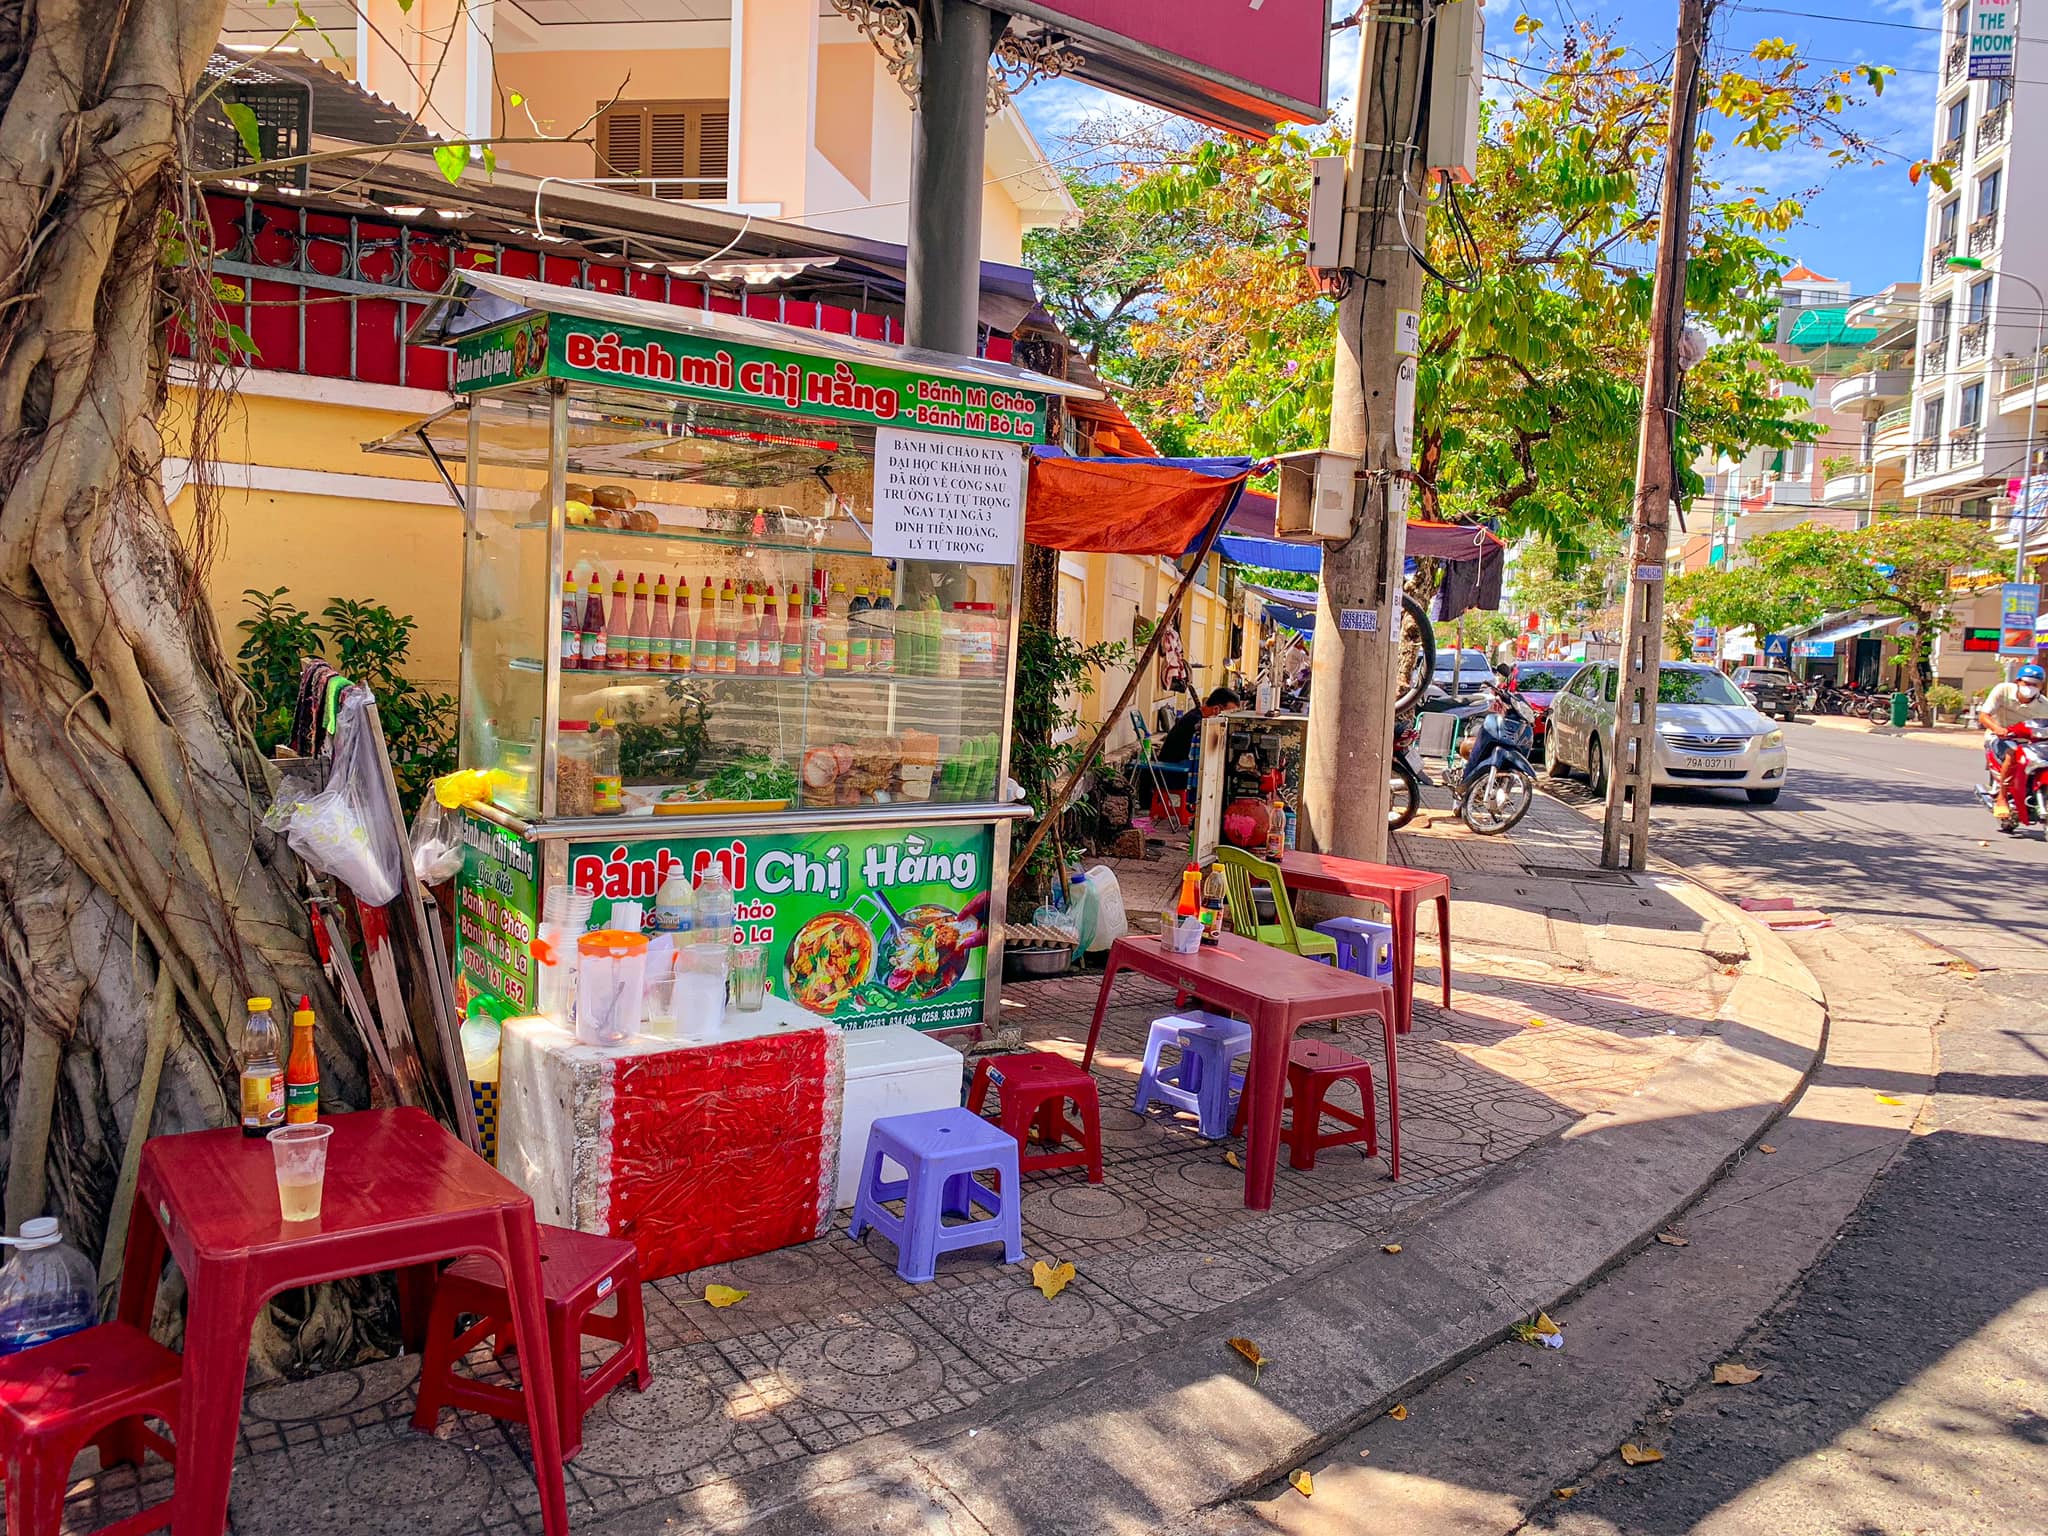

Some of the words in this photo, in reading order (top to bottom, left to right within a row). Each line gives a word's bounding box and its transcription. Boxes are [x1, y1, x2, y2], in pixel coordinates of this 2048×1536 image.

[1979, 12, 2006, 30] THE
[1972, 34, 2012, 52] MOON
[566, 332, 676, 382] Bánh
[680, 350, 734, 390] mì
[739, 361, 802, 408] Chị
[807, 361, 899, 419] Hằng
[917, 380, 962, 404] Bánh
[966, 384, 987, 408] Mì
[991, 391, 1036, 413] Chảo
[917, 404, 962, 427] Bánh
[965, 409, 986, 431] Mì
[989, 412, 1011, 434] Bò
[1014, 418, 1034, 437] La
[982, 448, 1004, 461] KTX
[889, 456, 910, 470] ĐẠI
[913, 459, 938, 474] HỌC
[985, 482, 1006, 493] SAU
[972, 496, 1011, 509] TRỌNG
[903, 505, 936, 519] NGAY
[938, 509, 957, 521] TẠI
[986, 511, 992, 522] 3
[946, 541, 984, 554] TRỌNG
[862, 833, 978, 889] Hằng
[462, 885, 484, 917] Bánh
[486, 899, 497, 925] Mì
[500, 908, 529, 944] Chảo
[734, 899, 775, 920] hảo
[750, 926, 774, 943] La
[461, 914, 484, 946] Bánh
[486, 928, 497, 957] Mì
[498, 938, 512, 966] Bò
[514, 946, 528, 977] La
[463, 945, 486, 978] 0706
[487, 961, 502, 992] 161
[504, 977, 525, 1007] 852
